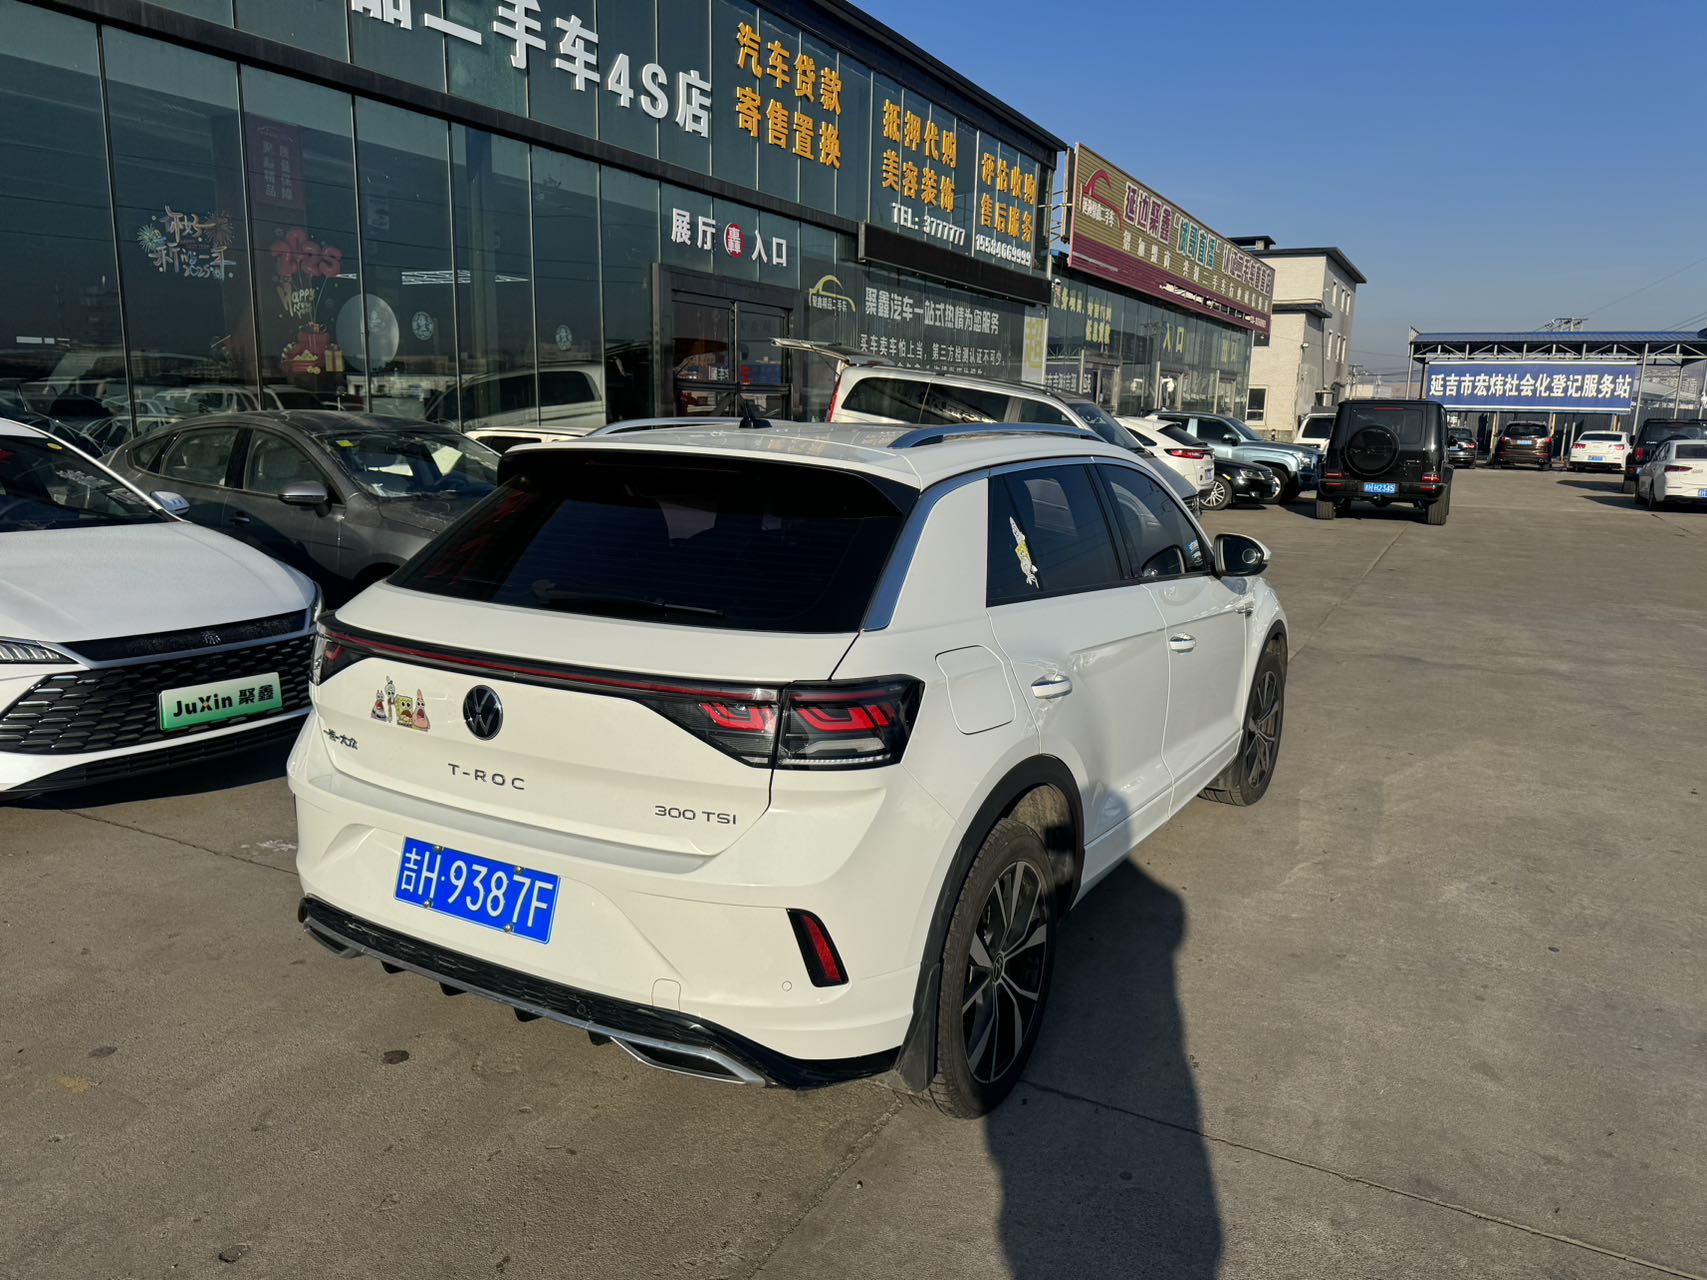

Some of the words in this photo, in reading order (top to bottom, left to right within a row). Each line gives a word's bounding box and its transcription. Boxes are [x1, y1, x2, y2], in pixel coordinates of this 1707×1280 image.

[736, 22, 842, 115] 汽车贷款
[736, 86, 841, 168] 寄售置换
[882, 149, 956, 213] 美容装饰
[671, 208, 716, 250] 展厅
[751, 229, 787, 267] 入口
[892, 202, 919, 229] TEL:
[923, 215, 966, 246] 3777777
[981, 193, 1033, 241] 售后服务
[865, 287, 999, 335] 聚鑫汽车一站式热情为您服务
[1163, 322, 1185, 353] 入口
[1429, 373, 1632, 399] 延吉市宏炜社会化登记服务站
[173, 693, 233, 717] JuXin
[239, 684, 274, 706] 聚鑫
[448, 763, 525, 791] T-ROC
[655, 805, 696, 821] 300
[702, 811, 736, 825] TSI
